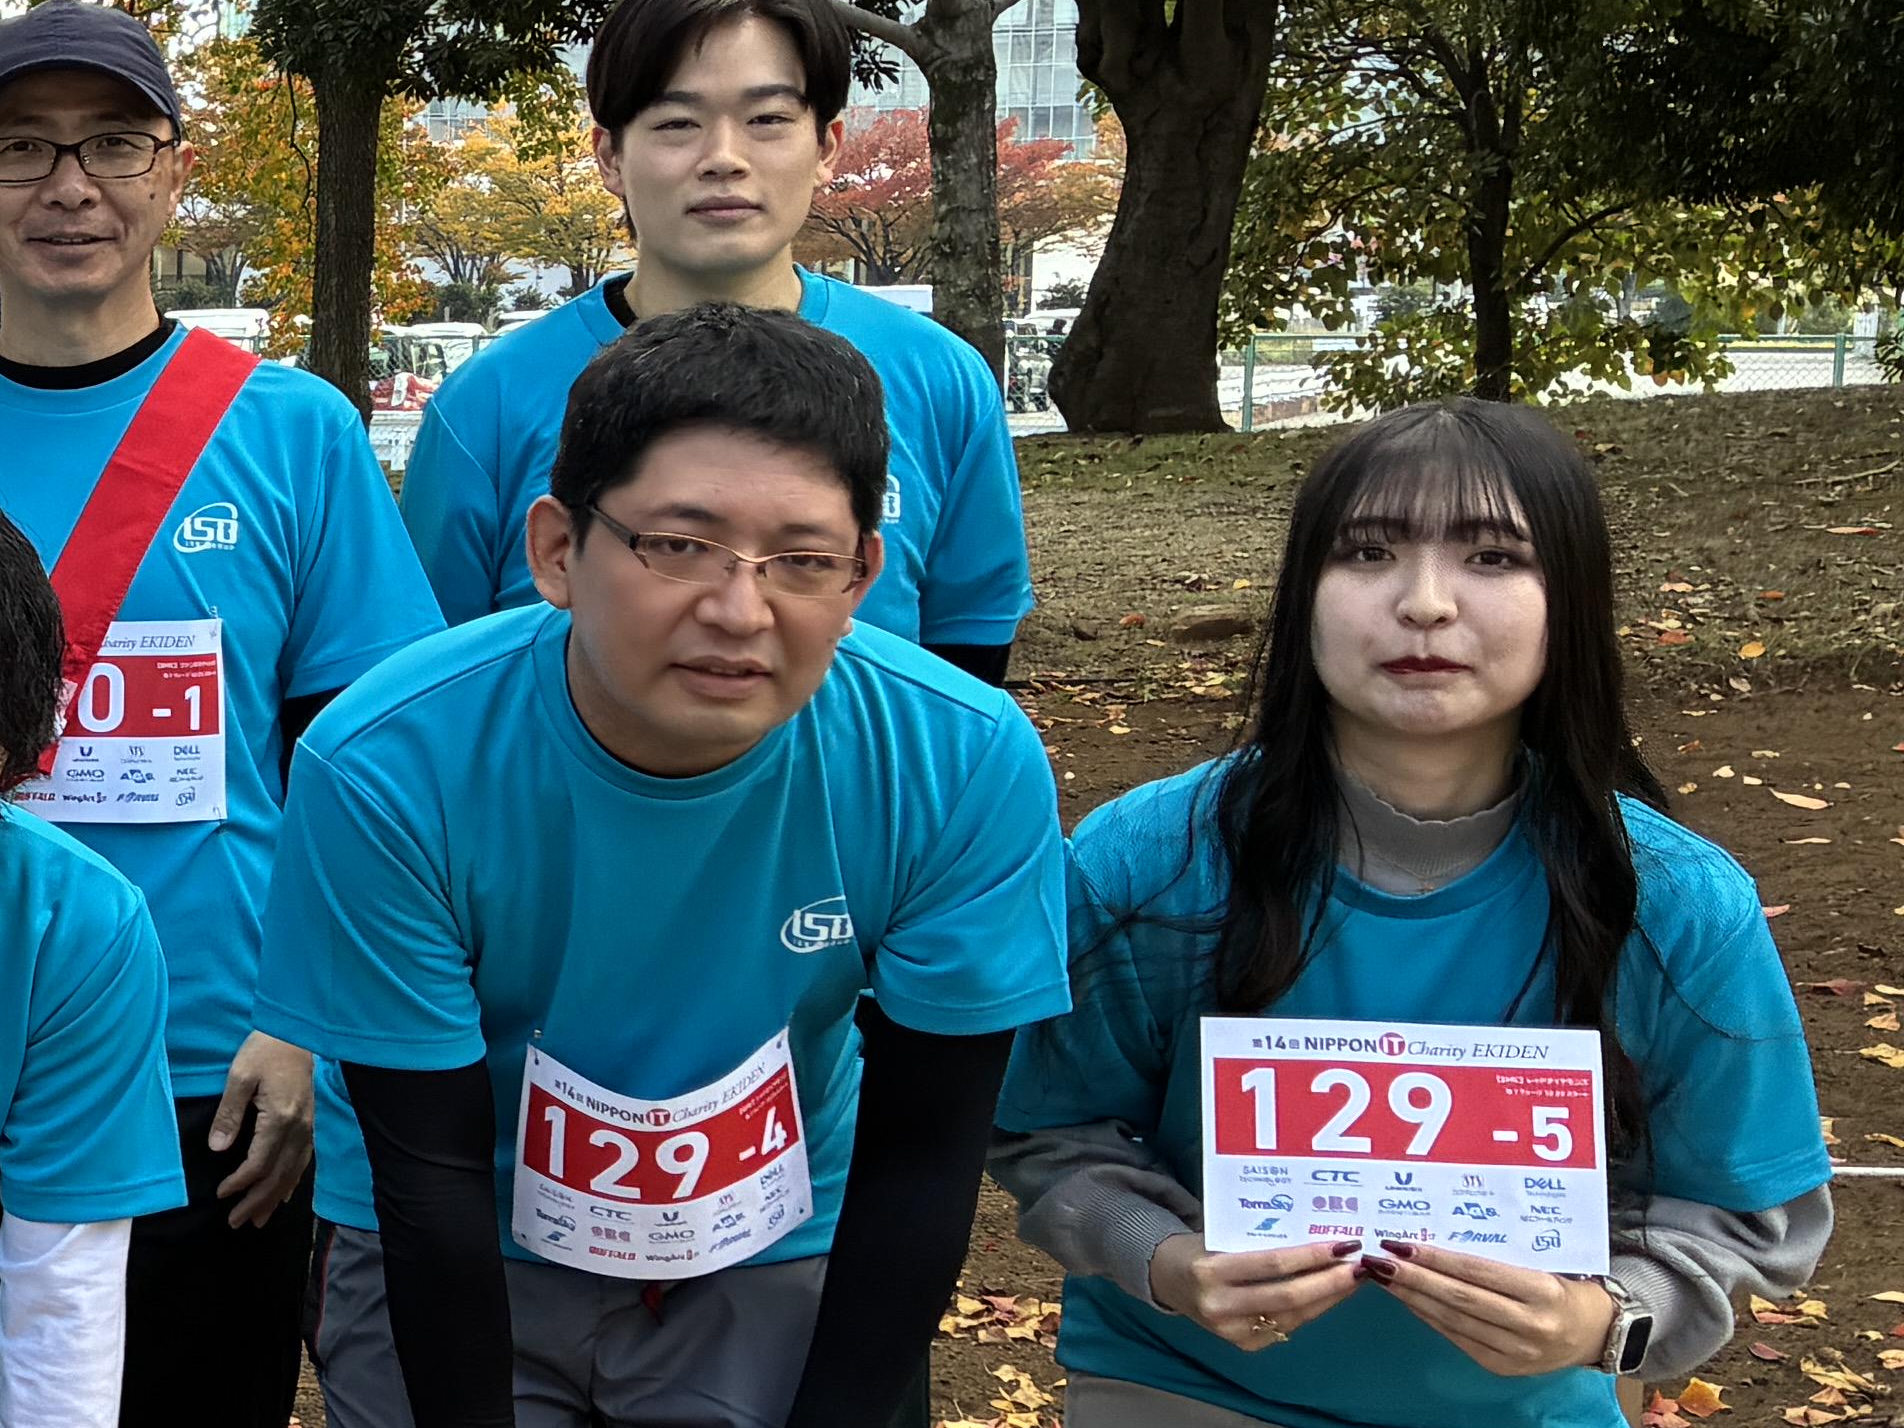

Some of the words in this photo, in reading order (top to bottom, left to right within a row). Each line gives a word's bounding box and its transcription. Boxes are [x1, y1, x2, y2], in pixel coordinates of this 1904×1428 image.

[139, 635, 196, 648] EKIDEN
[1304, 1036, 1377, 1053] NIPPON
[1407, 1040, 1466, 1062] Charity
[1472, 1043, 1549, 1060] EKIDEN
[585, 1098, 645, 1125] NIPPON
[672, 1099, 719, 1124] Charity
[721, 1061, 768, 1105] EKIDEN
[1241, 1067, 1453, 1155] 129
[543, 1104, 710, 1200] 129
[1311, 1169, 1360, 1183] CTC
[1524, 1177, 1566, 1190] DELL
[590, 1205, 632, 1221] CTC
[1378, 1198, 1431, 1211] GMO
[1308, 1224, 1364, 1237] BUFFALO
